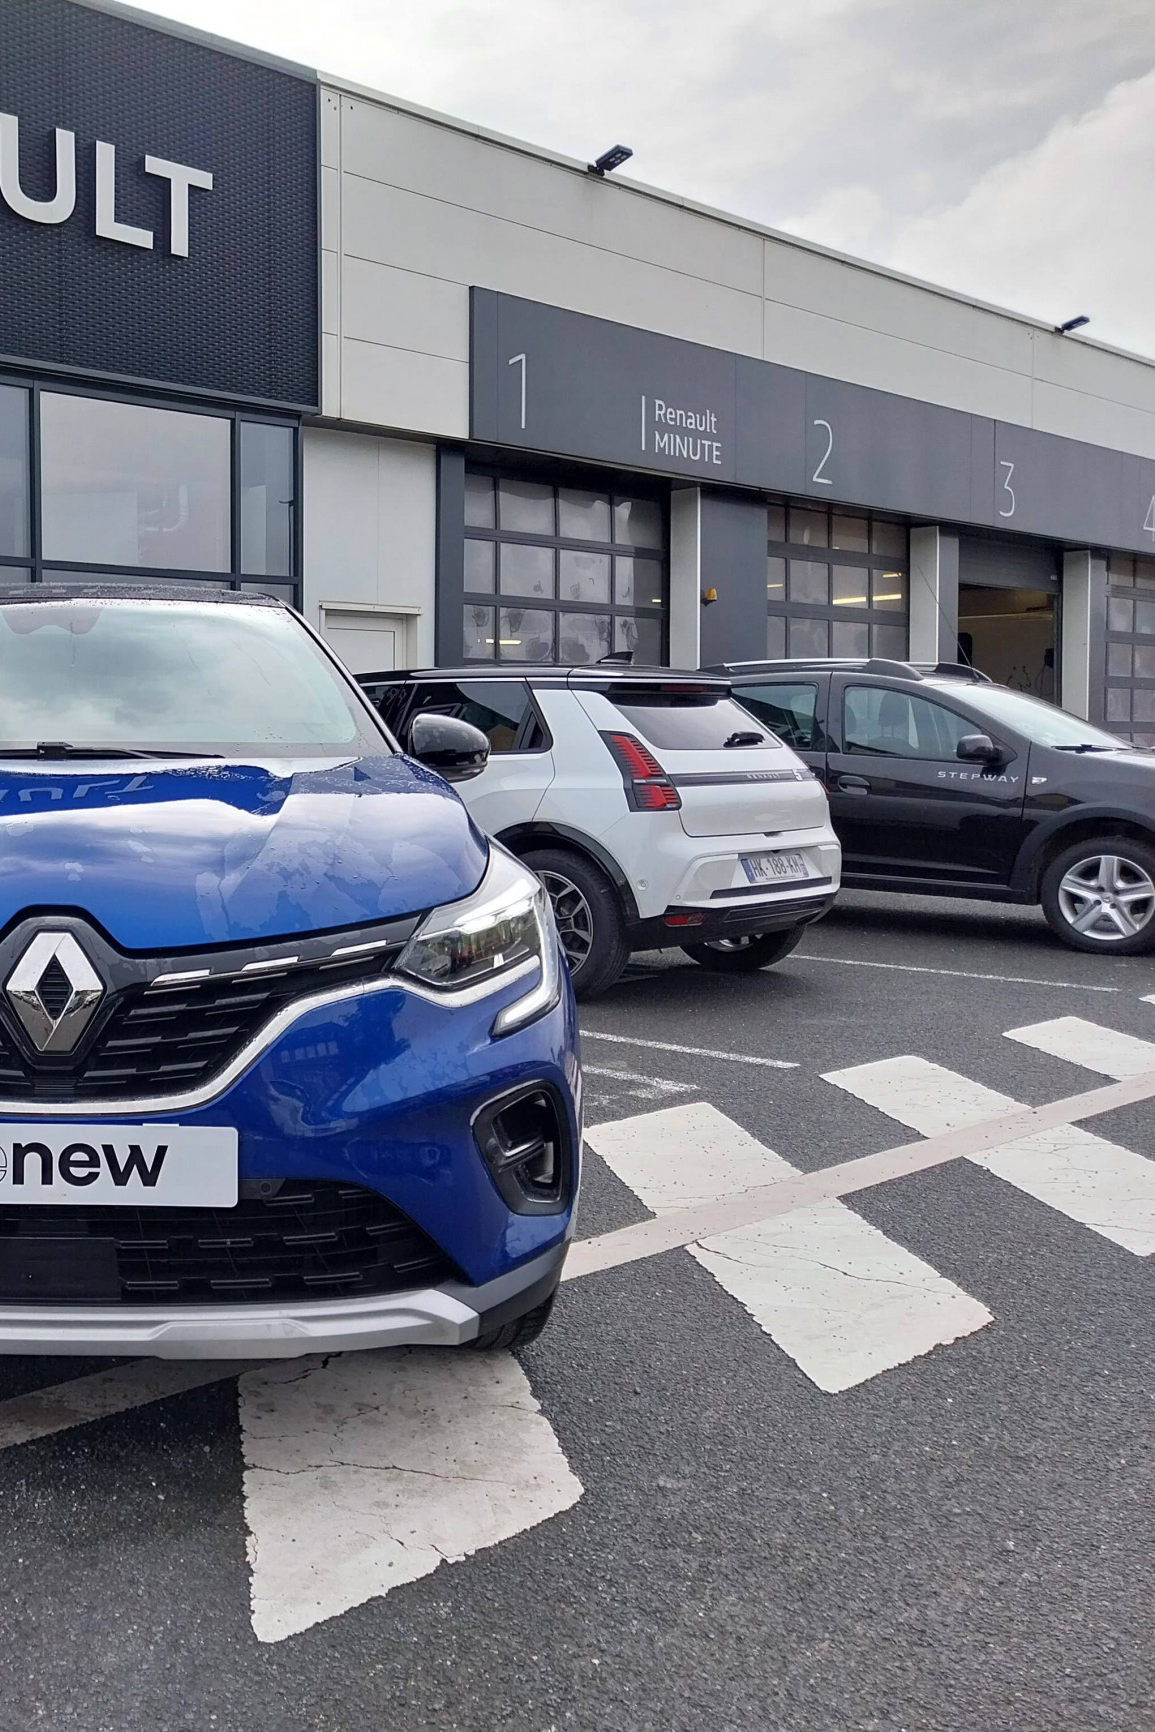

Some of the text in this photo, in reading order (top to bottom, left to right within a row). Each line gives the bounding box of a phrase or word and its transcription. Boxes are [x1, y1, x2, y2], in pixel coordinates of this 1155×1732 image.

[508, 353, 526, 429] 1
[654, 399, 717, 434] Renault
[654, 430, 722, 465] MINUTE
[812, 419, 833, 485] 2
[999, 461, 1015, 517] 3
[937, 771, 1019, 784] STEPWAY
